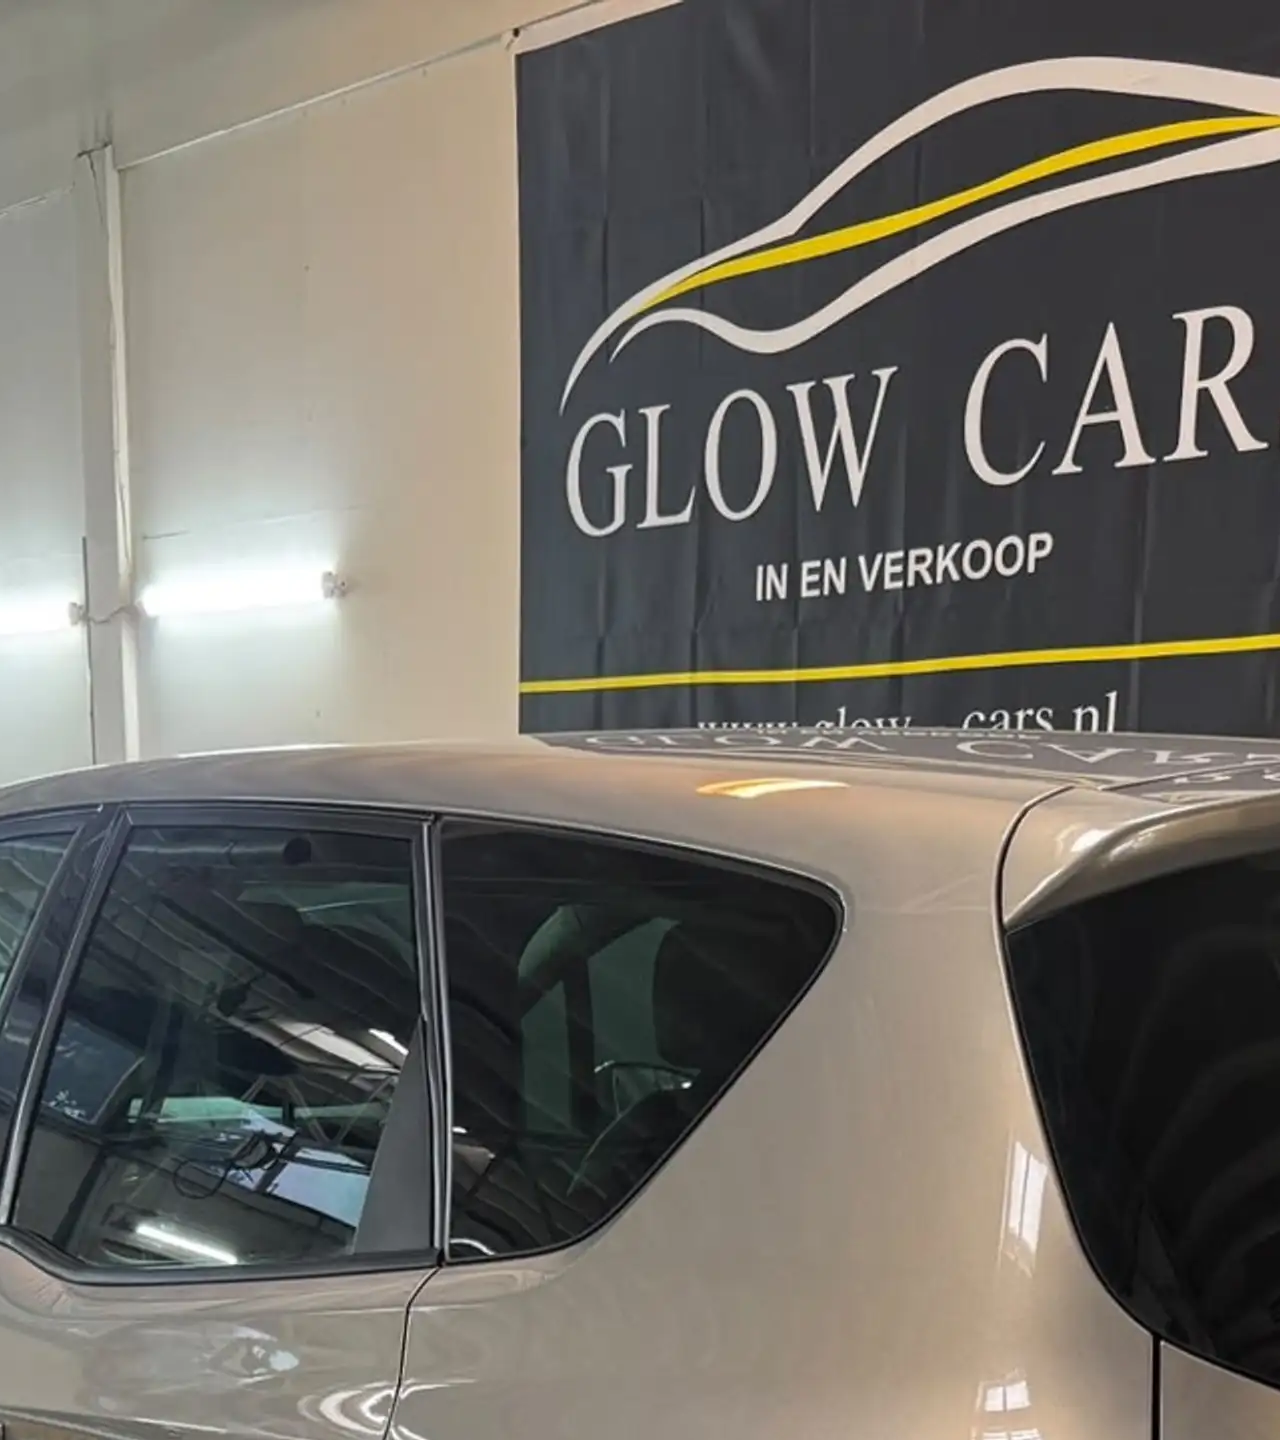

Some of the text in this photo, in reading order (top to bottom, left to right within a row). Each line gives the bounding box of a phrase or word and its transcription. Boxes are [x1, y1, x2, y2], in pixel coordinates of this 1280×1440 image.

[565, 365, 898, 538] GLOW
[755, 532, 1054, 601] IN EN VERKOOP
